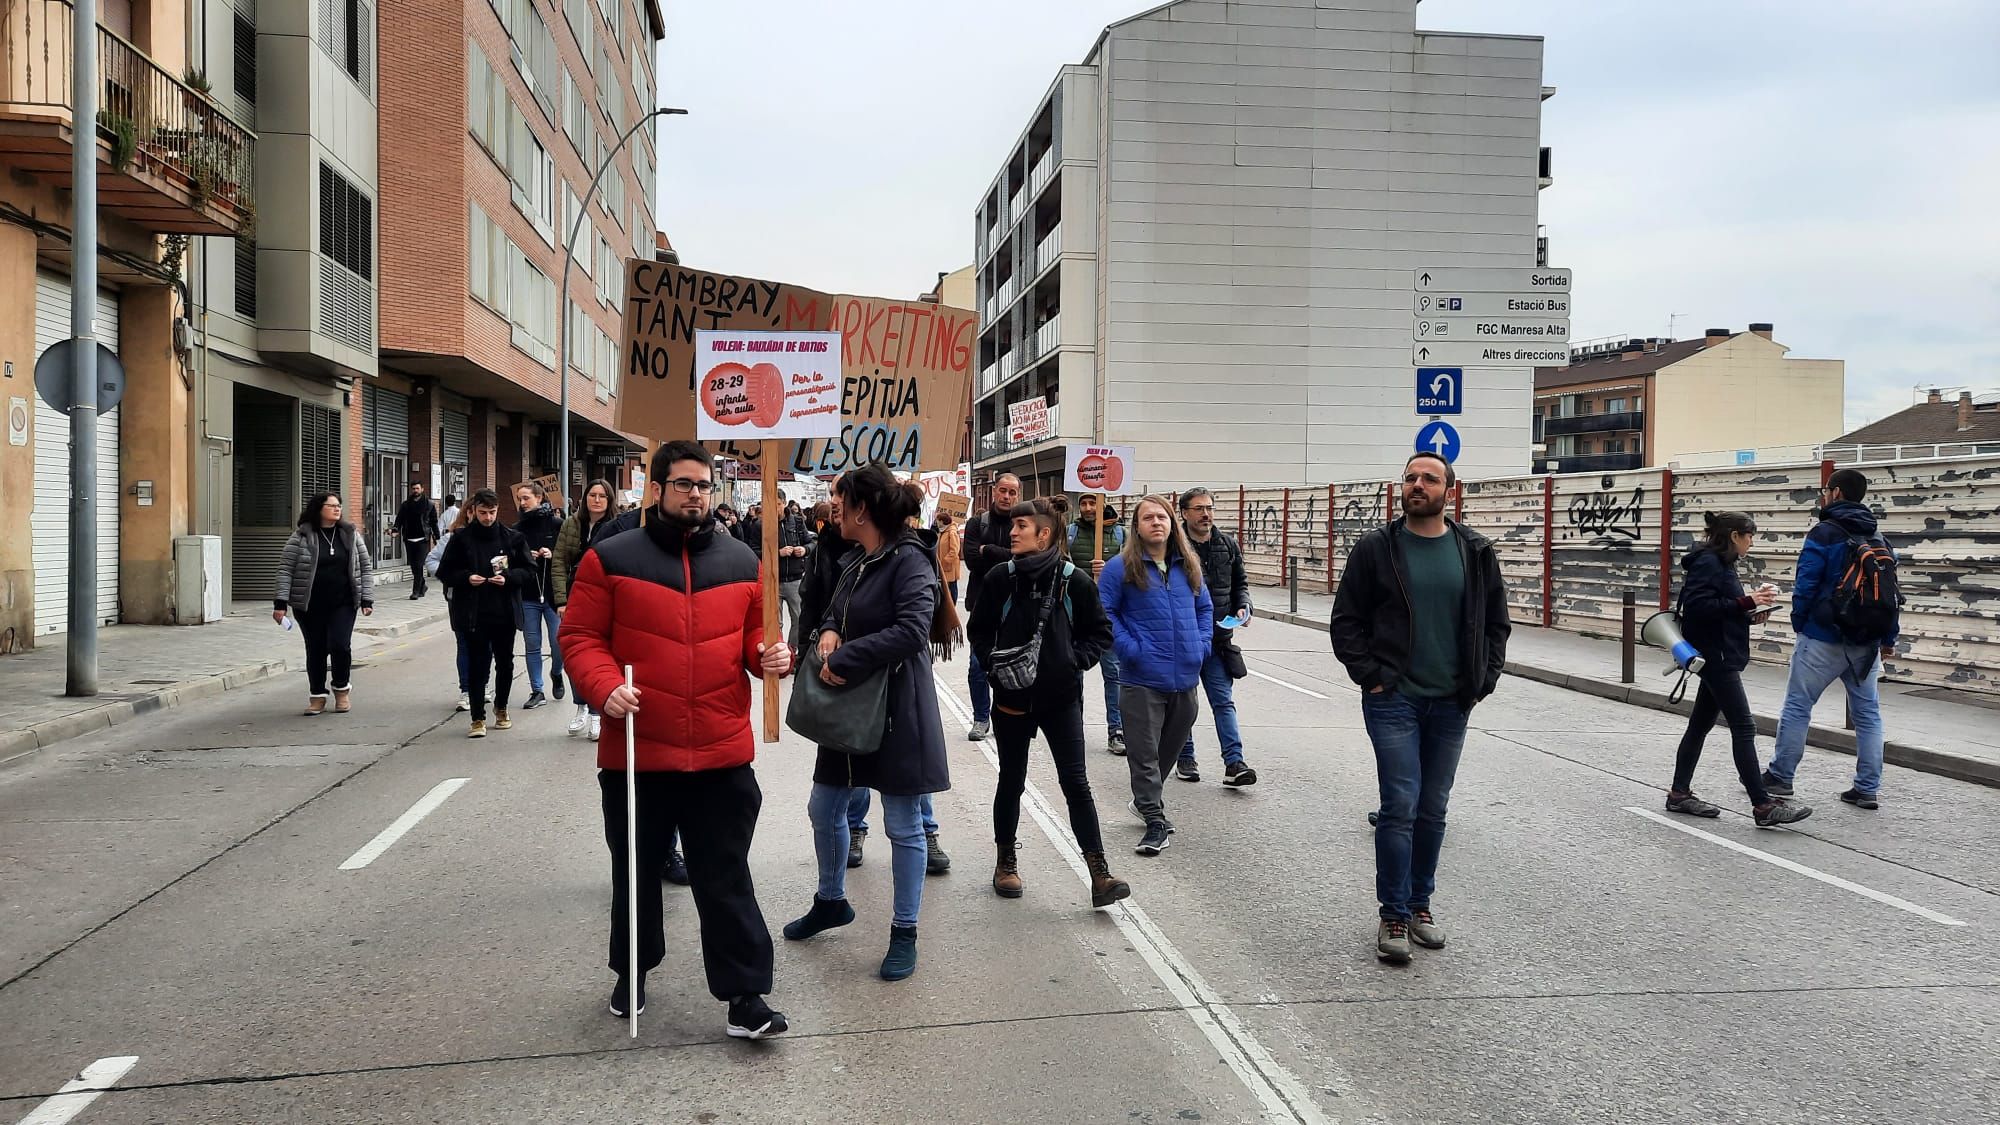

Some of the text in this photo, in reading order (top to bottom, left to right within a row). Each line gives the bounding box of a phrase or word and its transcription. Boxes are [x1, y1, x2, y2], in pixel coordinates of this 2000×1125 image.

[1531, 274, 1567, 287] Sortida
[634, 264, 781, 327] CAMBRAY,
[1508, 299, 1544, 311] Estació
[1547, 300, 1567, 311] Bus
[1476, 323, 1566, 336] FGC Manresa Alta
[785, 341, 798, 352] DE
[798, 341, 829, 353] RATIOS
[631, 340, 669, 379] NO
[1482, 348, 1566, 361] Altres direccions
[710, 375, 744, 392] 28-29
[841, 369, 919, 418] EPITJA
[716, 393, 749, 409] infants
[1419, 398, 1437, 407] 250
[735, 402, 756, 414] aula
[794, 425, 919, 472] LESCOLA
